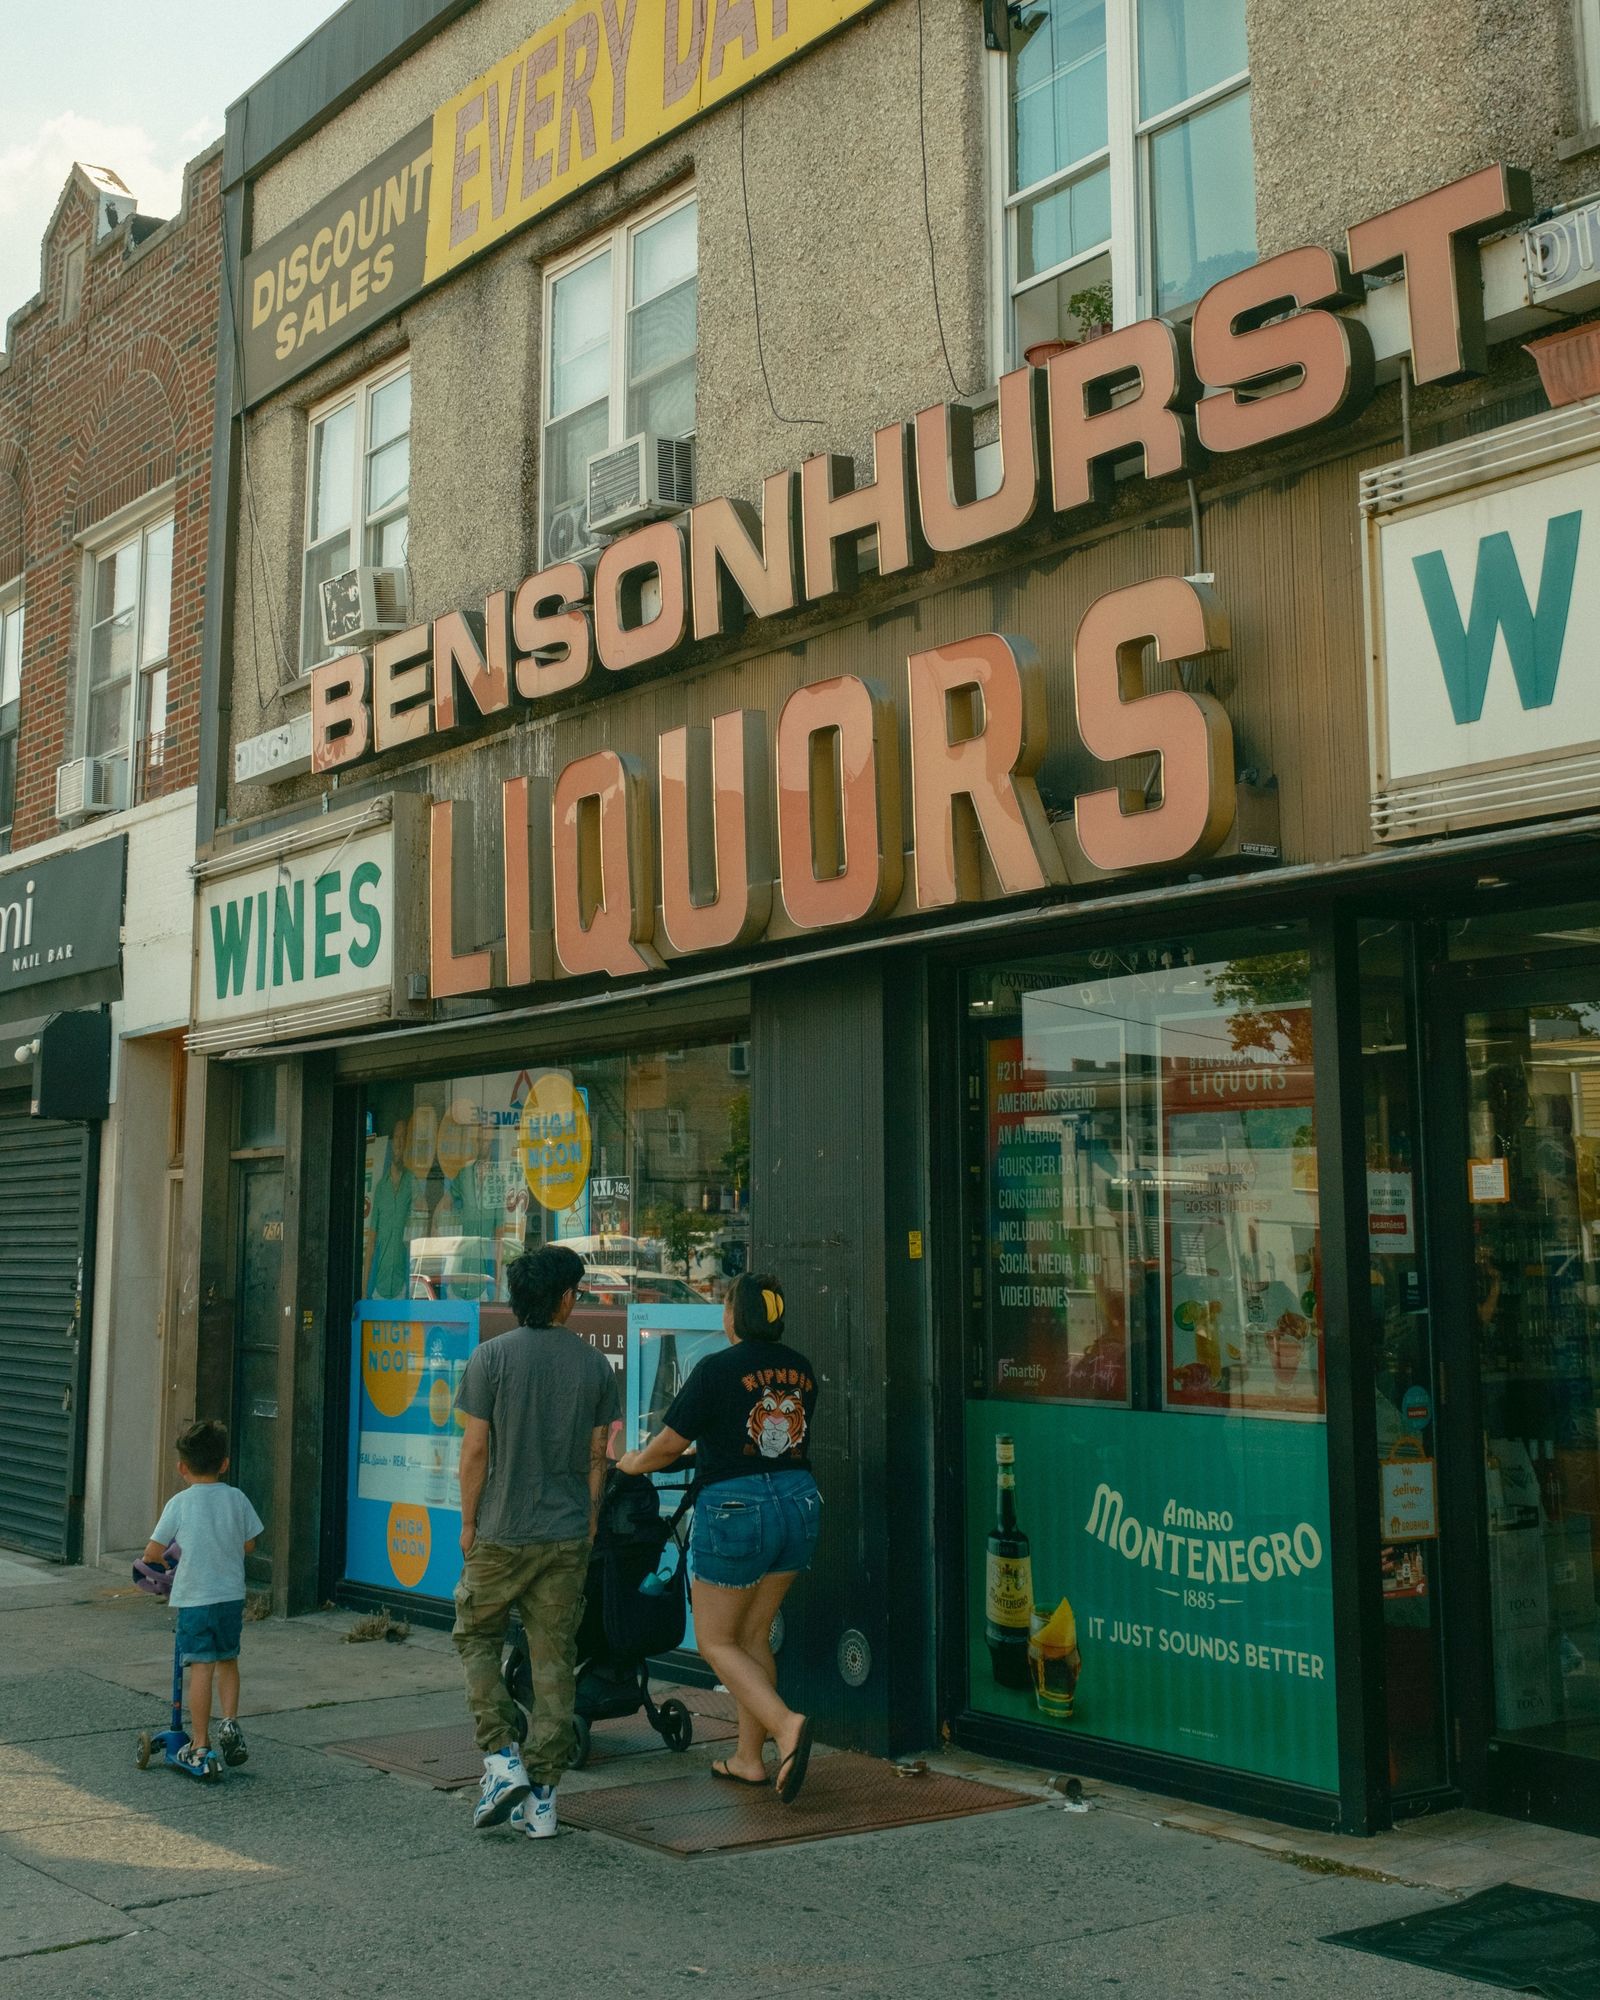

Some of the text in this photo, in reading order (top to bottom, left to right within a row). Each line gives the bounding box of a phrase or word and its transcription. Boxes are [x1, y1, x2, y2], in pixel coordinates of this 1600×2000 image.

[449, 0, 637, 251] EVERY
[252, 147, 432, 330] DISCOUNT
[275, 243, 395, 360] SALES
[311, 163, 1509, 774] BENSONHURST
[430, 575, 1212, 999] LIQUORS
[210, 860, 383, 1000] WINES
[12, 944, 73, 972] NAIL BAR
[1190, 1066, 1287, 1098] LIQUORS
[997, 1087, 1097, 1113] AMERICANS SPEND
[998, 1126, 1012, 1145] AN
[527, 1140, 583, 1169] NOON
[998, 1155, 1033, 1177] HOURS
[1035, 1154, 1056, 1176] PER
[592, 1180, 630, 1196] XXL 16%
[999, 1188, 1060, 1209] CONSUMING
[999, 1221, 1054, 1241] INCLUDING
[1372, 1220, 1405, 1230] seamless
[999, 1254, 1038, 1274] SOCIAL
[1079, 1253, 1101, 1274] AND
[999, 1286, 1031, 1307] VIDEO
[1003, 1363, 1047, 1382] Smartify
[1392, 1482, 1425, 1497] deliver
[395, 1519, 423, 1537] HIGH
[1085, 1483, 1323, 1584] MONTENEGRO
[393, 1538, 426, 1557] NOON
[1183, 1589, 1216, 1610] 1885
[1089, 1617, 1324, 1680] IT JUST SOUNDS BETTER
